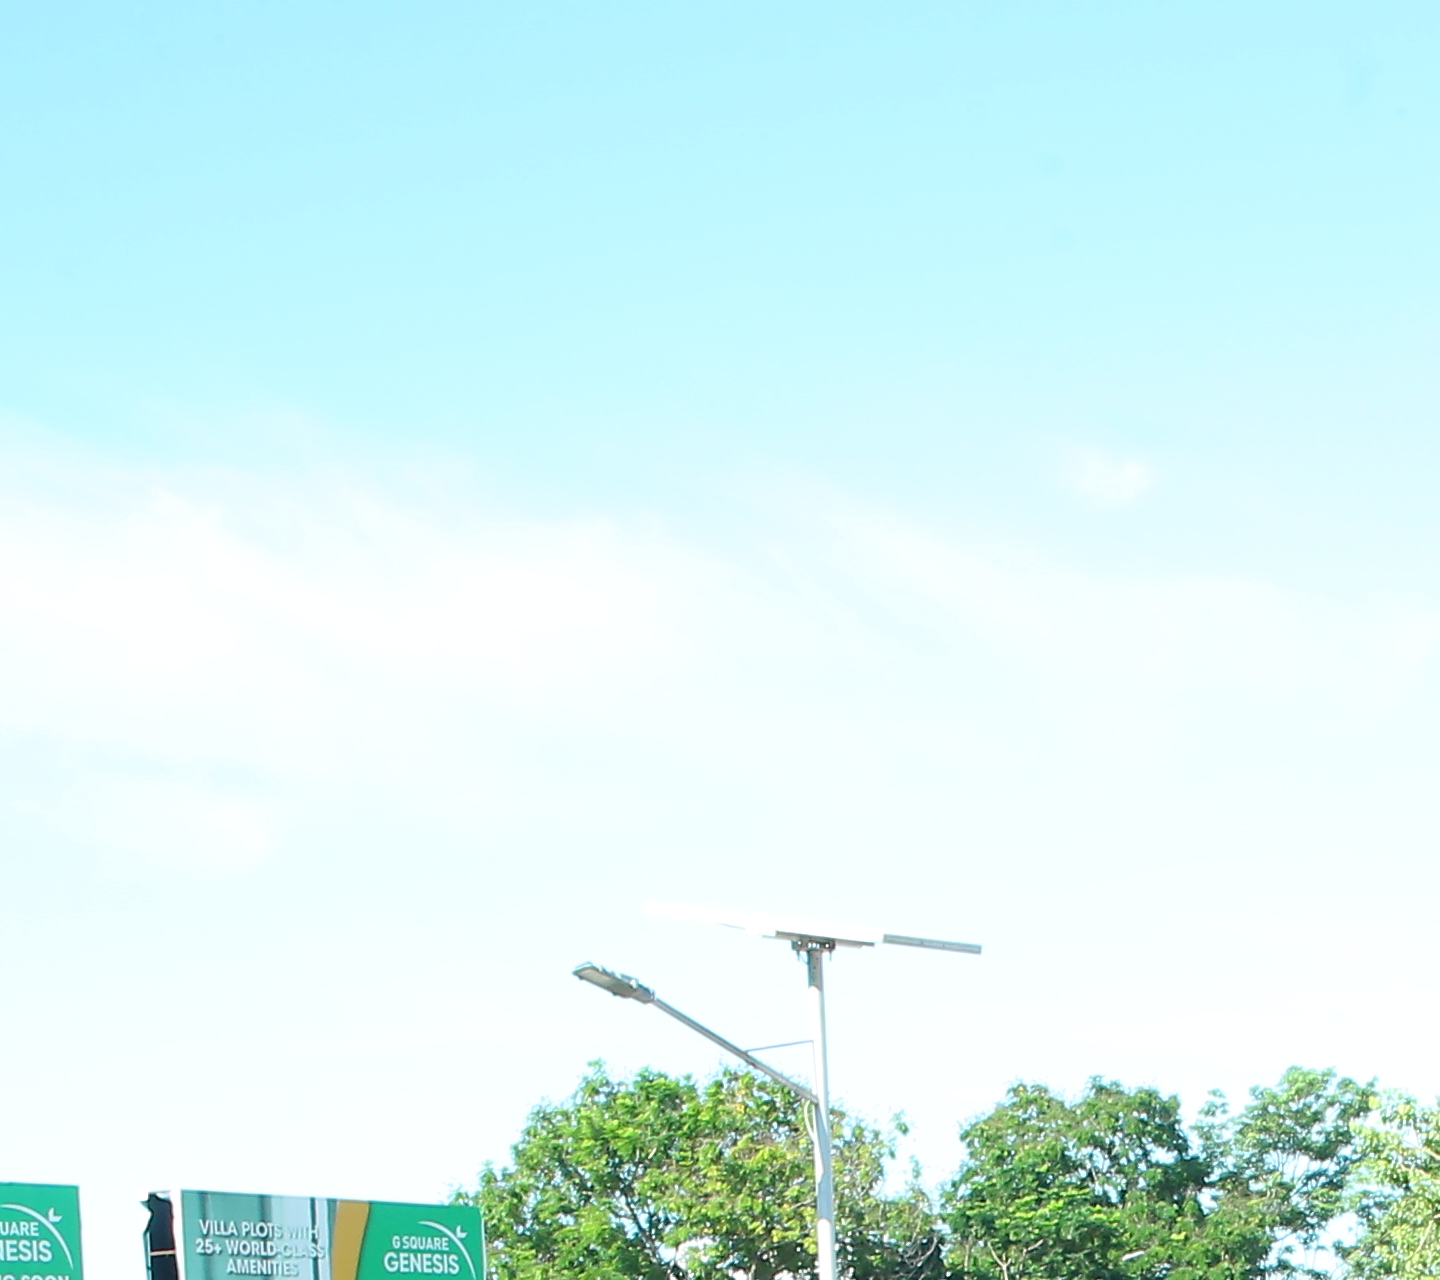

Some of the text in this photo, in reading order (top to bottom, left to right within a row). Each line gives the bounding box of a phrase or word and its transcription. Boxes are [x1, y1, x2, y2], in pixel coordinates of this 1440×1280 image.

[199, 1219, 319, 1240] VILLA PLOTS WITH
[195, 1238, 325, 1259] 25+ WORLD-CLASS
[392, 1235, 449, 1251] G SQUARE
[226, 1259, 299, 1276] AMENITIES
[383, 1251, 460, 1275] GENESIS
